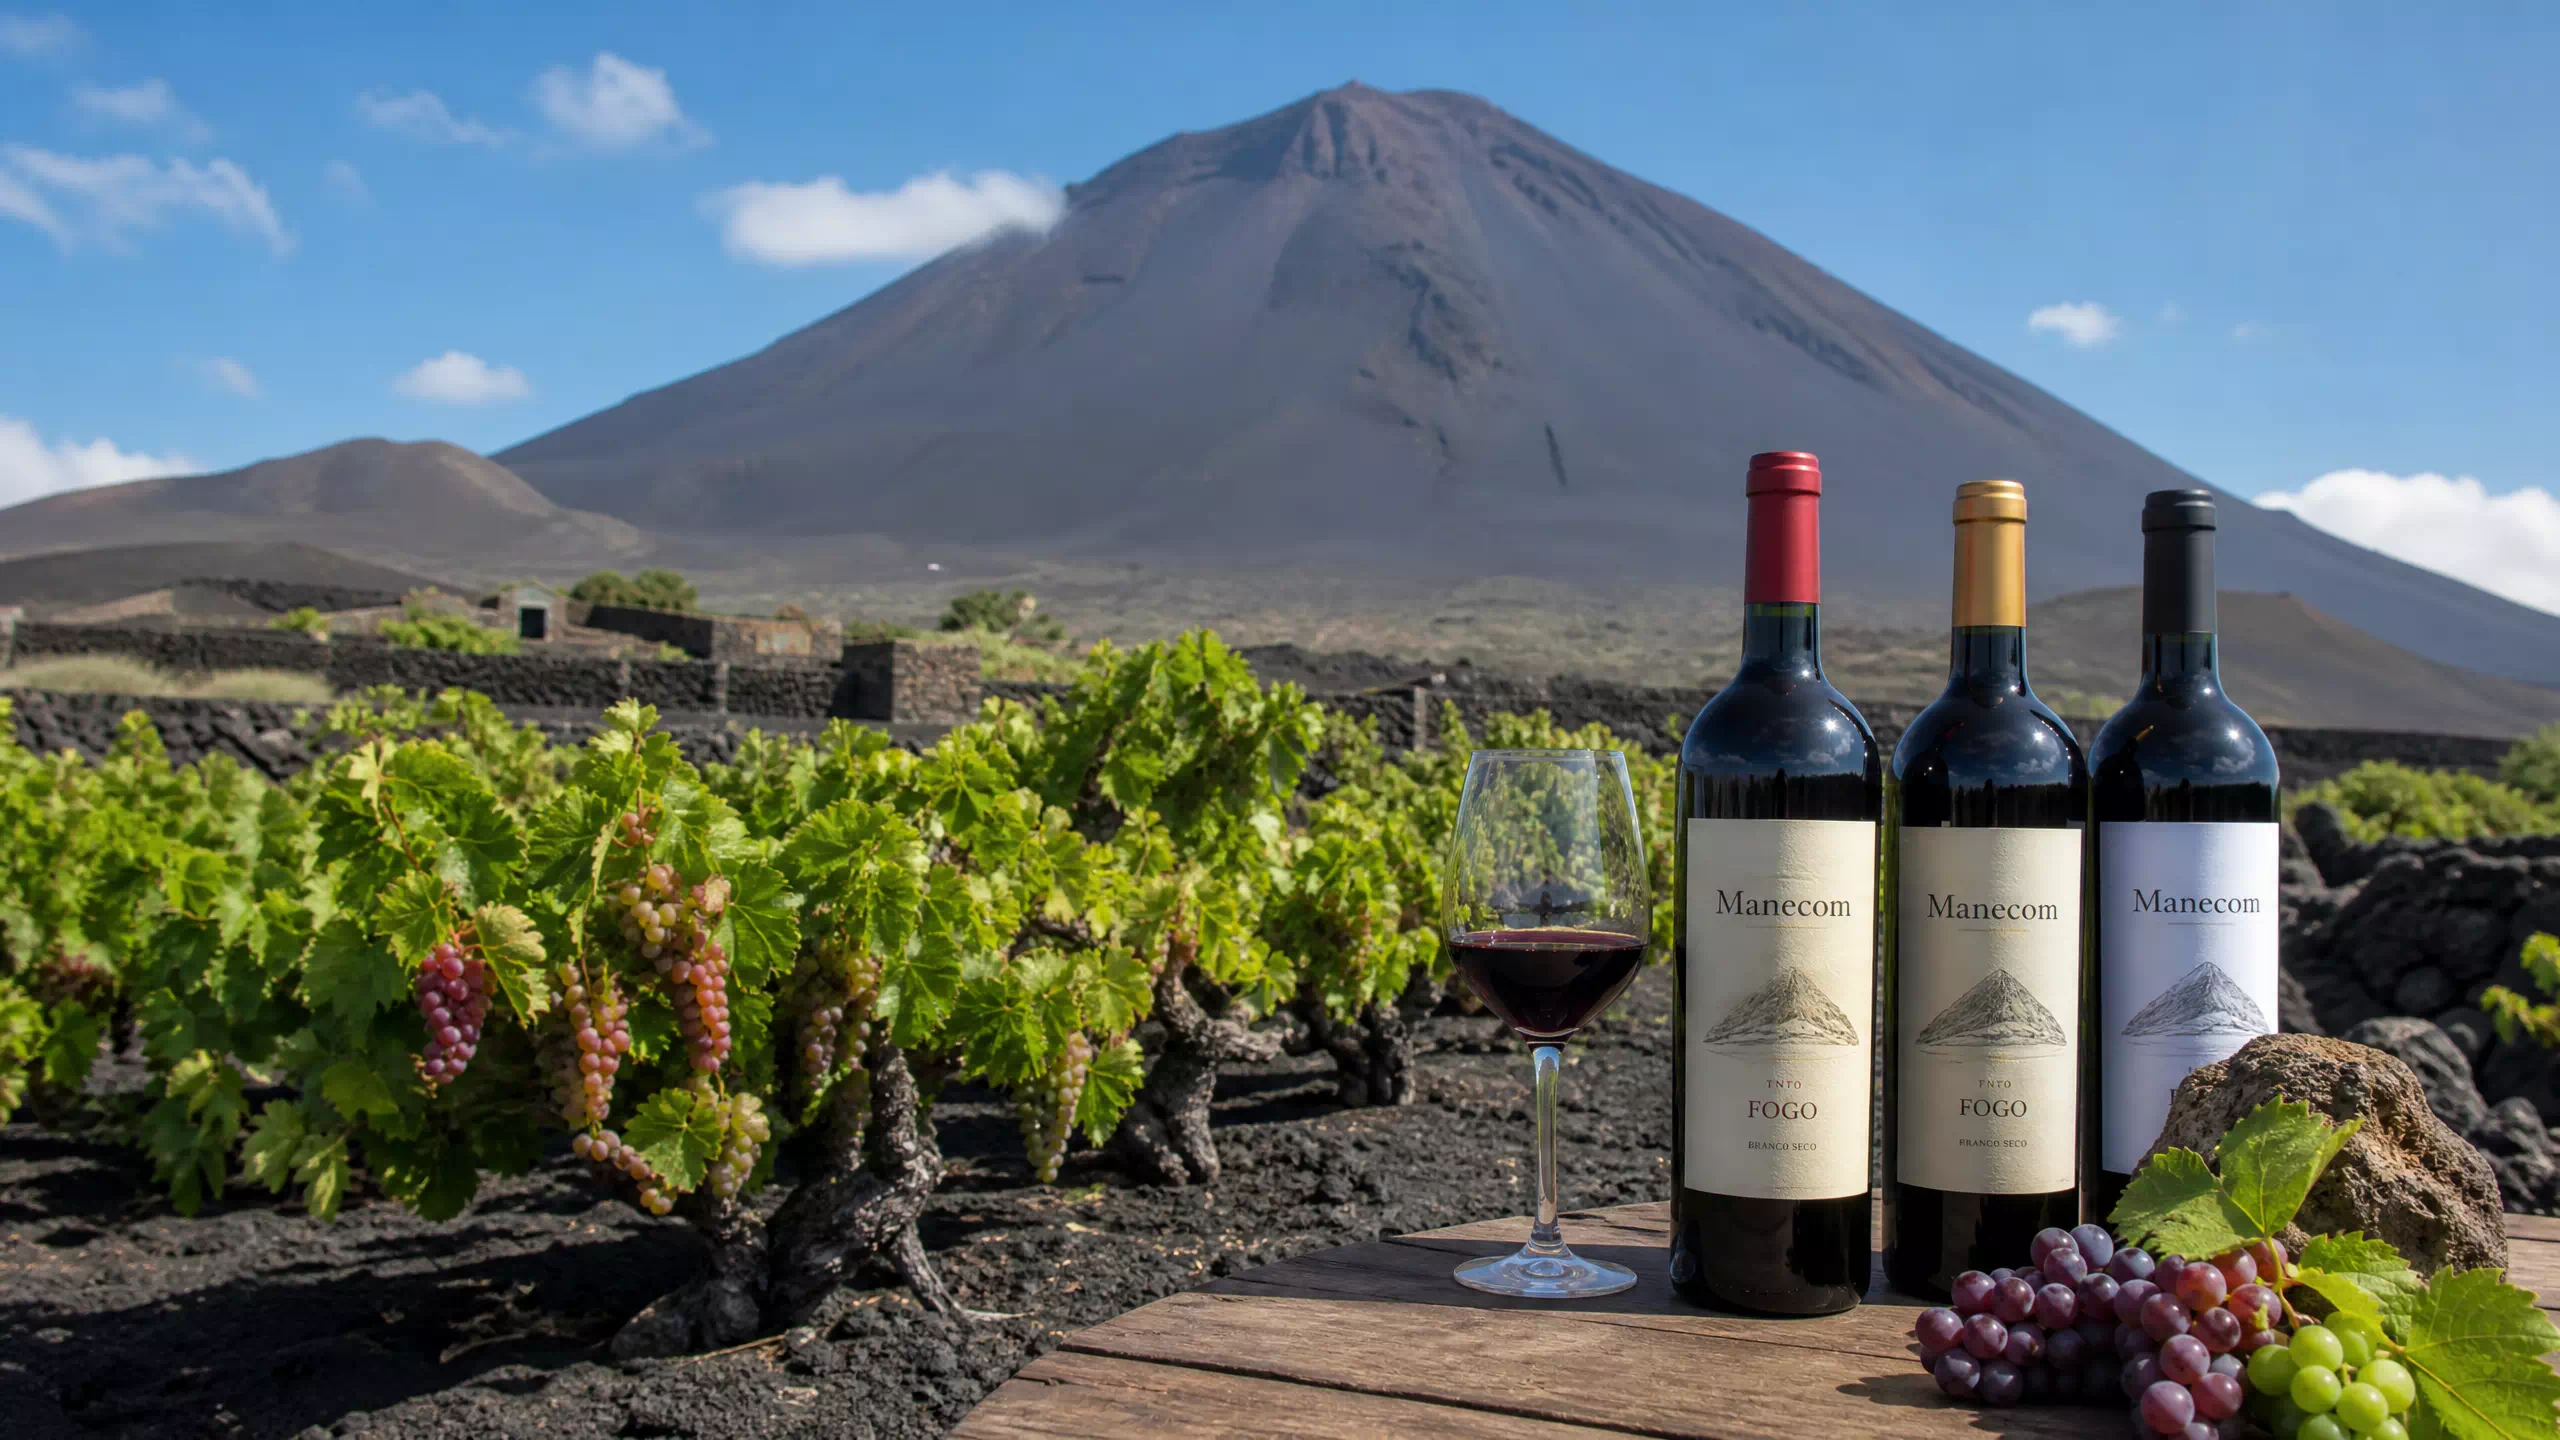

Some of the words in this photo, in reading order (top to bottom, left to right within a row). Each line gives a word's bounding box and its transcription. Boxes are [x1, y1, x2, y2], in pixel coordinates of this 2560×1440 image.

[1715, 888, 1851, 918] Manecom
[1926, 893, 2059, 921] Manecom
[2132, 888, 2261, 914] Manecom
[1747, 1100, 1818, 1120] FOGO
[1959, 1098, 2028, 1118] FOGO
[1747, 1140, 1790, 1151] BRANCO
[1791, 1142, 1818, 1151] SECO
[2002, 1139, 2028, 1148] SECO
